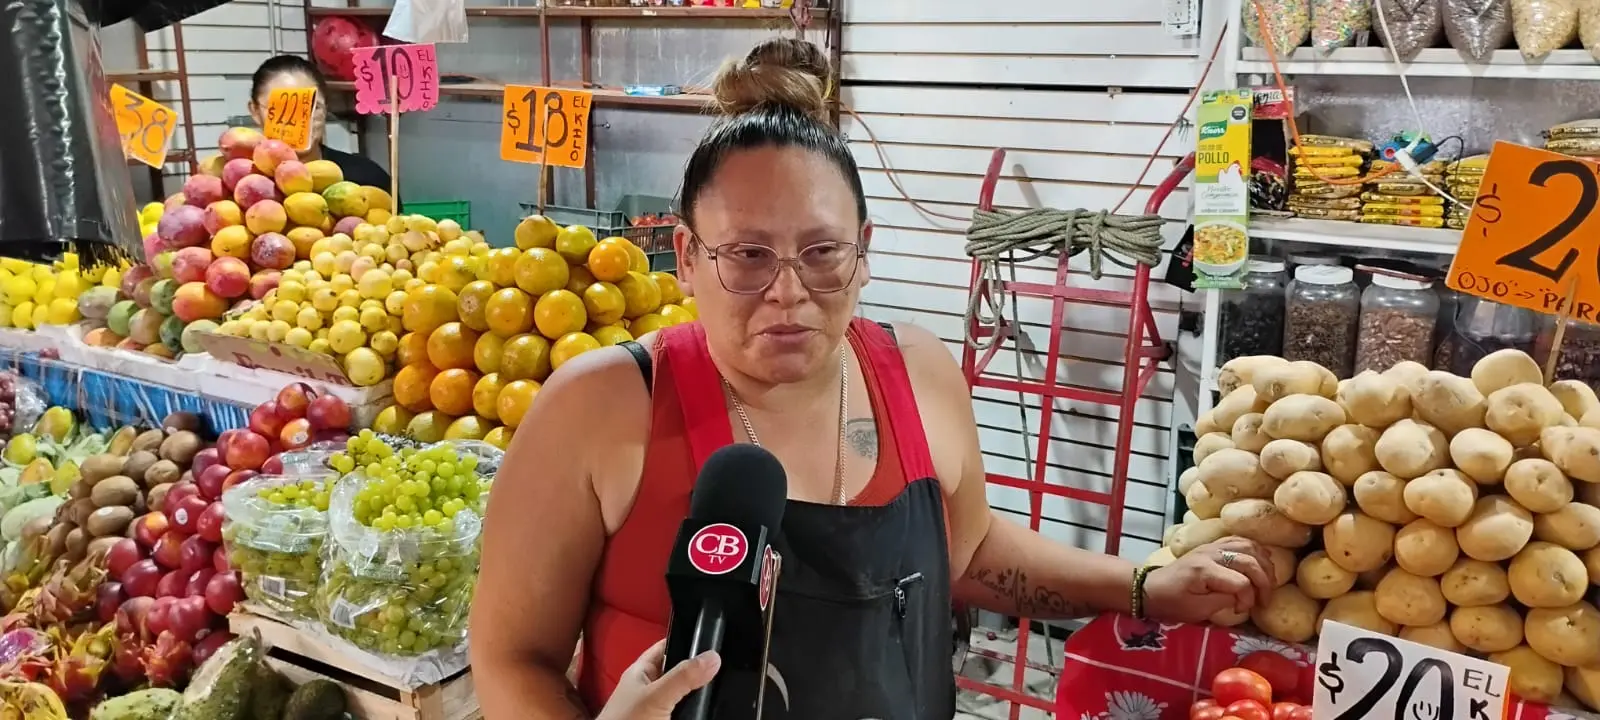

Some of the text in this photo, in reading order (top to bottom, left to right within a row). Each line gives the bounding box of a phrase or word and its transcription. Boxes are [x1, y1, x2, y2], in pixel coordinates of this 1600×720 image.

[416, 48, 434, 62] EL
[419, 66, 433, 109] KILO
[573, 95, 587, 109] EL
[124, 91, 169, 154] 38
[570, 113, 583, 161] KILO
[1198, 151, 1230, 164] POLLO
[695, 533, 740, 556] CB
[708, 554, 727, 564] TV
[1463, 668, 1501, 698] EL
